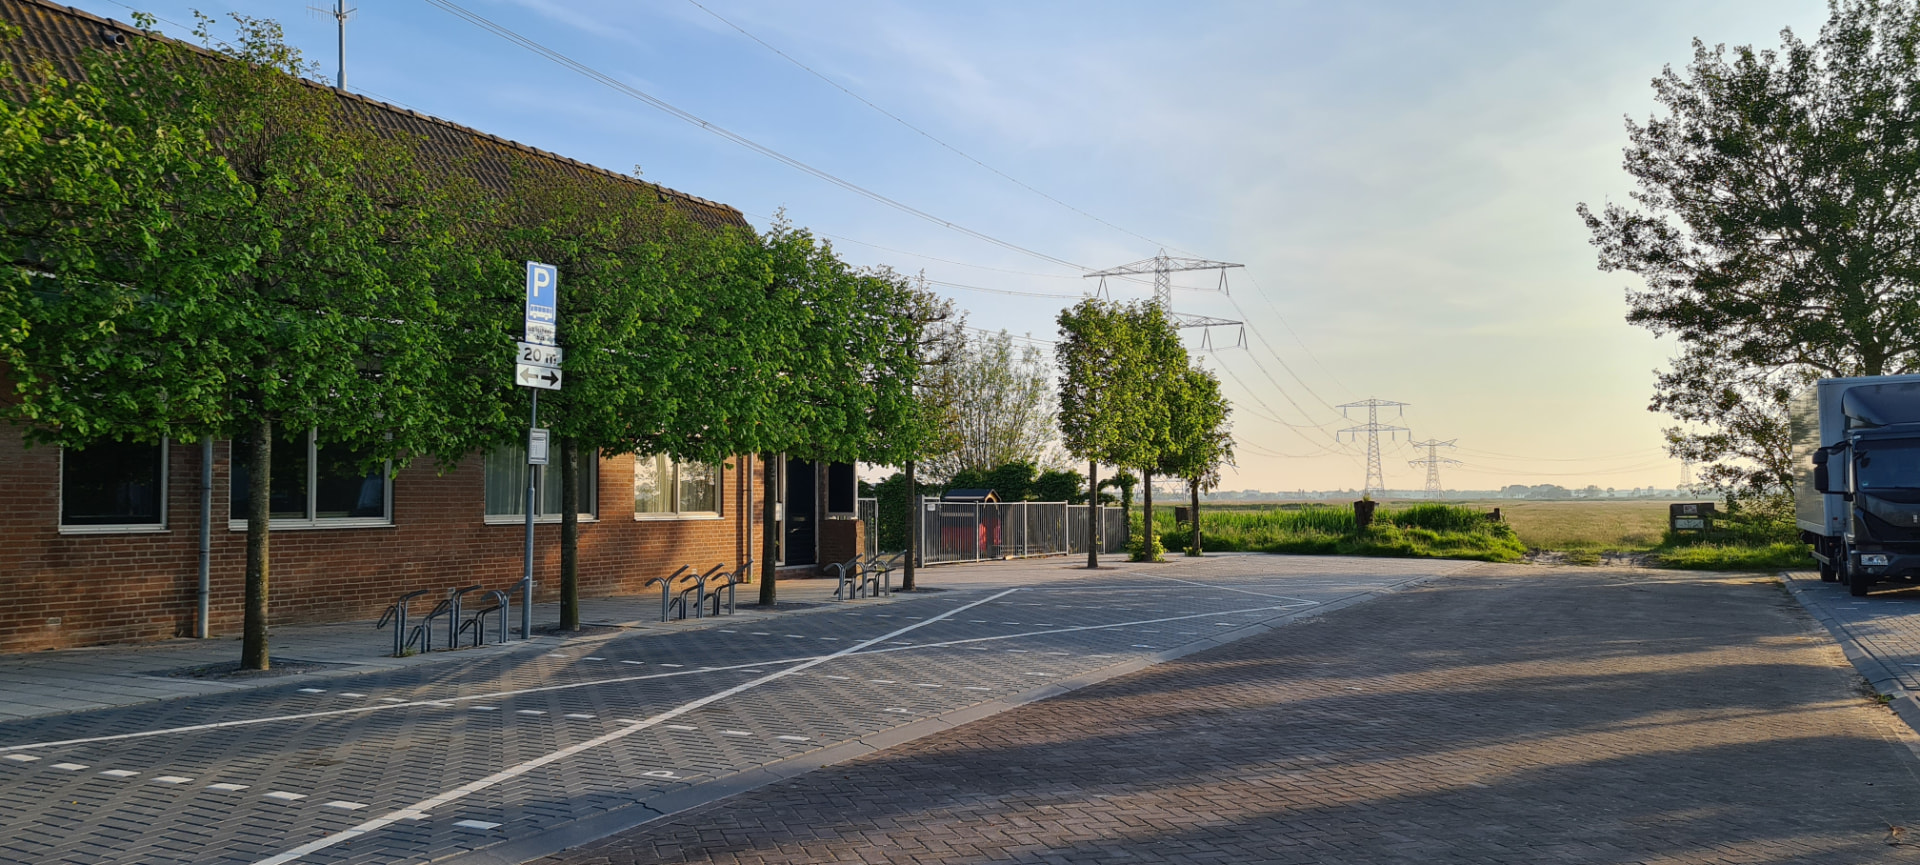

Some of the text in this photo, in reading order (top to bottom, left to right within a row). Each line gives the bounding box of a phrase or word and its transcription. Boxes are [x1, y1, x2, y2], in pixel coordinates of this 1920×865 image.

[533, 267, 550, 297] P
[524, 347, 541, 362] 20
[641, 770, 682, 779] P
